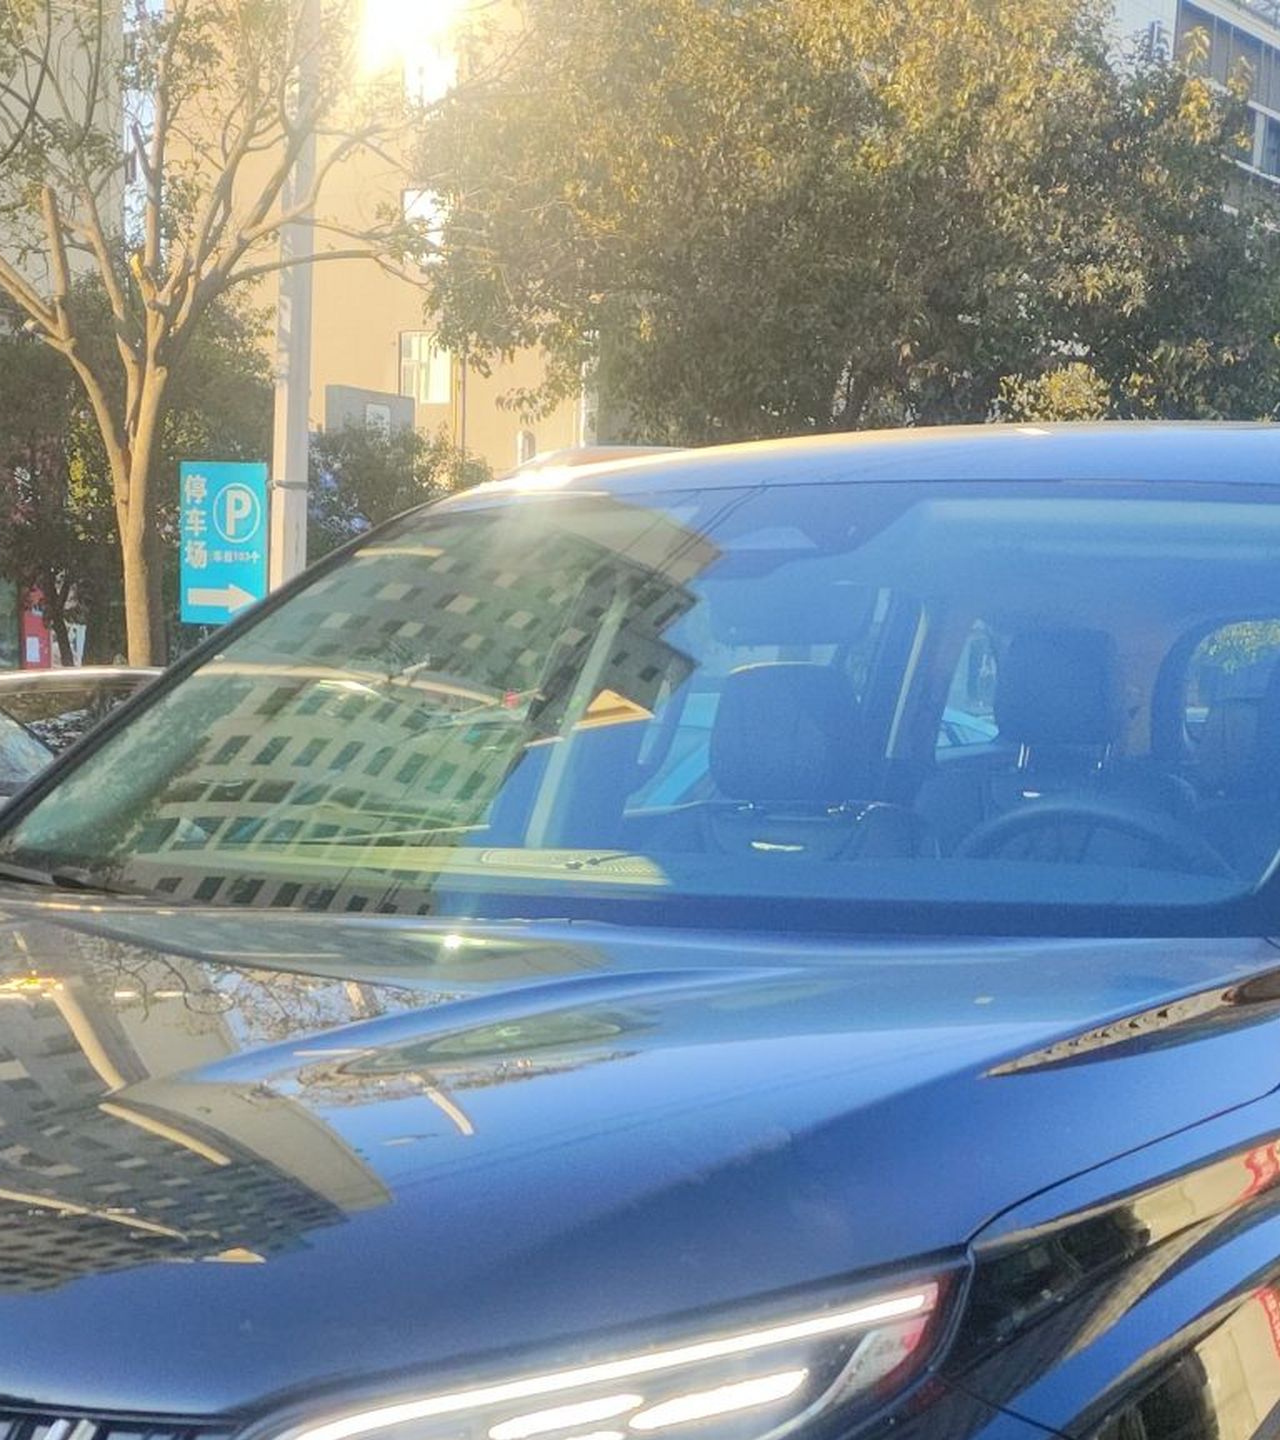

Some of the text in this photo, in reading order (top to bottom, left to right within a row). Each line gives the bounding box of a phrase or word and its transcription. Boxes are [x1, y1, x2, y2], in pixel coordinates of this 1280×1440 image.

[185, 474, 208, 569] 停车场
[225, 489, 252, 536] P
